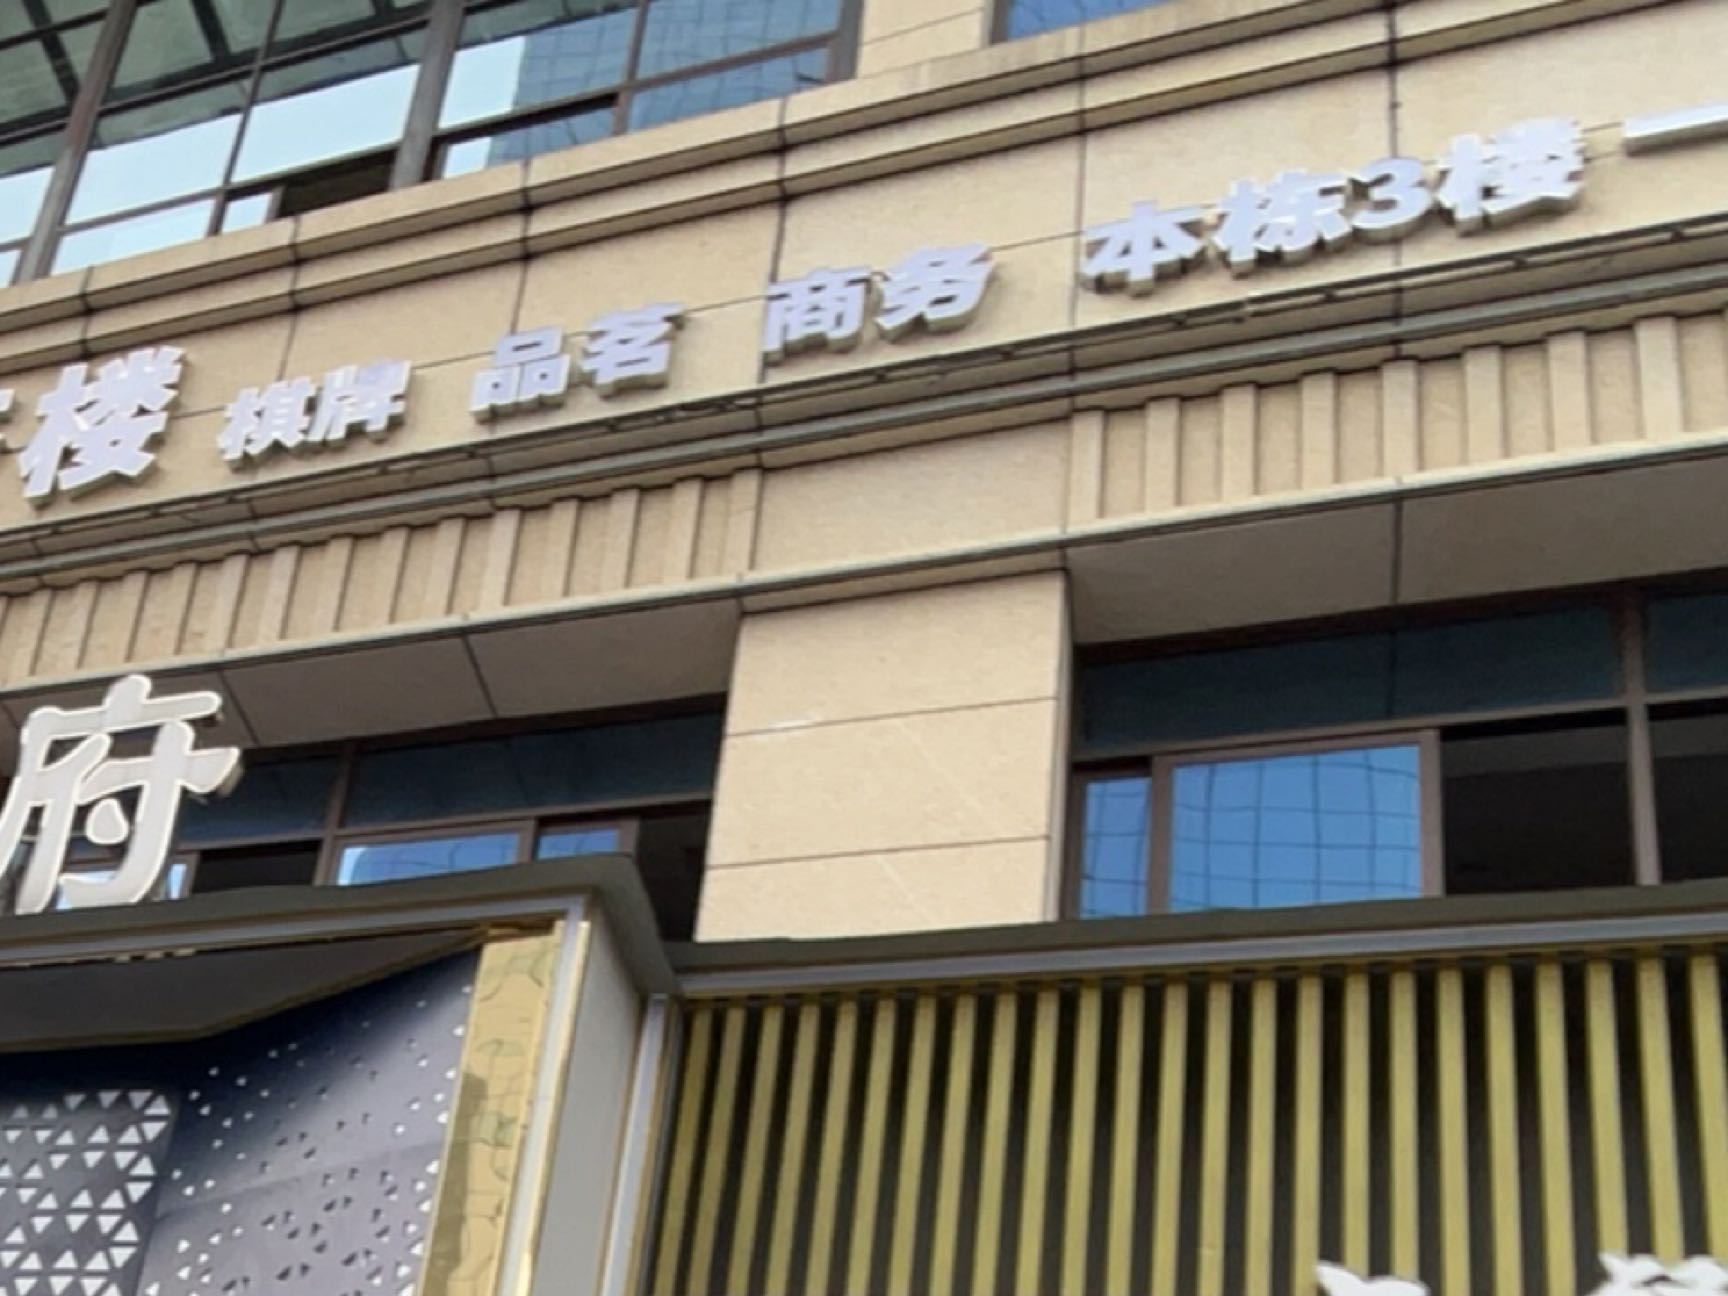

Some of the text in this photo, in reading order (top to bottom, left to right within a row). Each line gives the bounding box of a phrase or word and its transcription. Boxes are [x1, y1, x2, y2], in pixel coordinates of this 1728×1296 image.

[218, 359, 412, 462] 棋牌
[469, 303, 683, 421] 品茗
[762, 242, 996, 364] 商务
